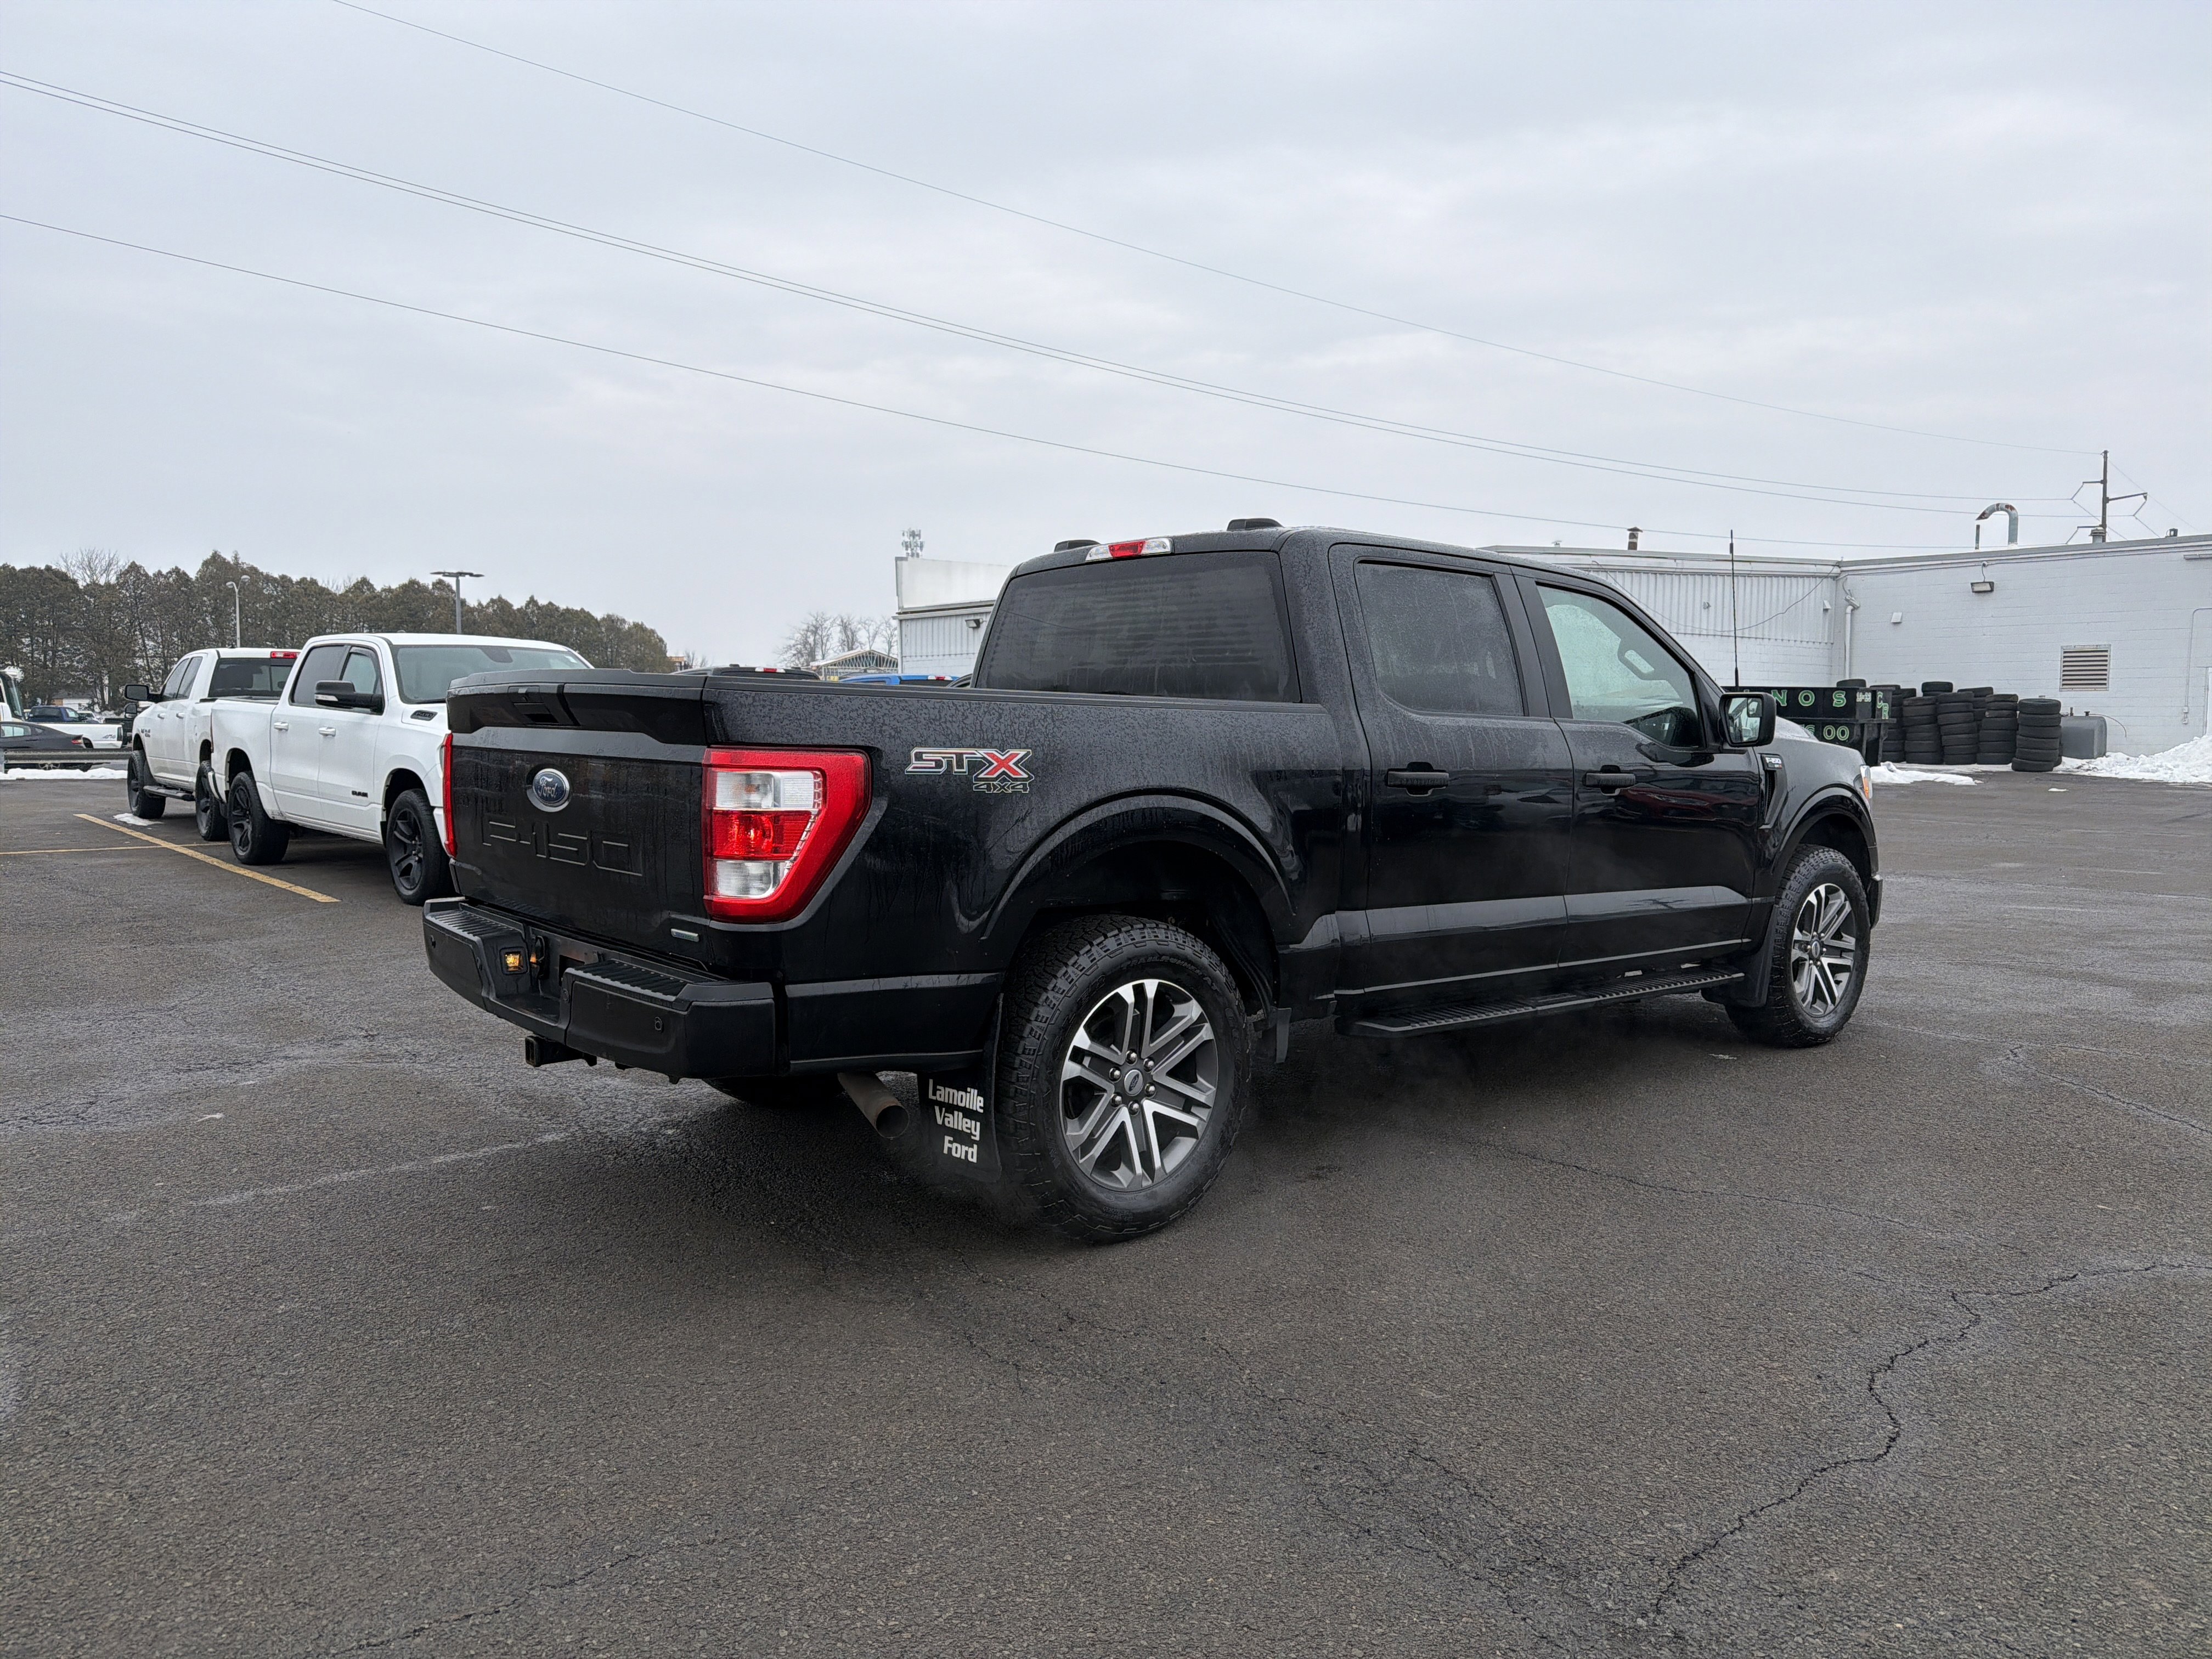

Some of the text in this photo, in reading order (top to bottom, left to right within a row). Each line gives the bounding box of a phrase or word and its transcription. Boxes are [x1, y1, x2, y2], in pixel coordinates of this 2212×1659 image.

[905, 748, 1034, 782] STX
[538, 776, 558, 799] Ford
[928, 1079, 984, 1113] Lamoille
[934, 1105, 980, 1141] Valley
[943, 1135, 978, 1163] Ford
